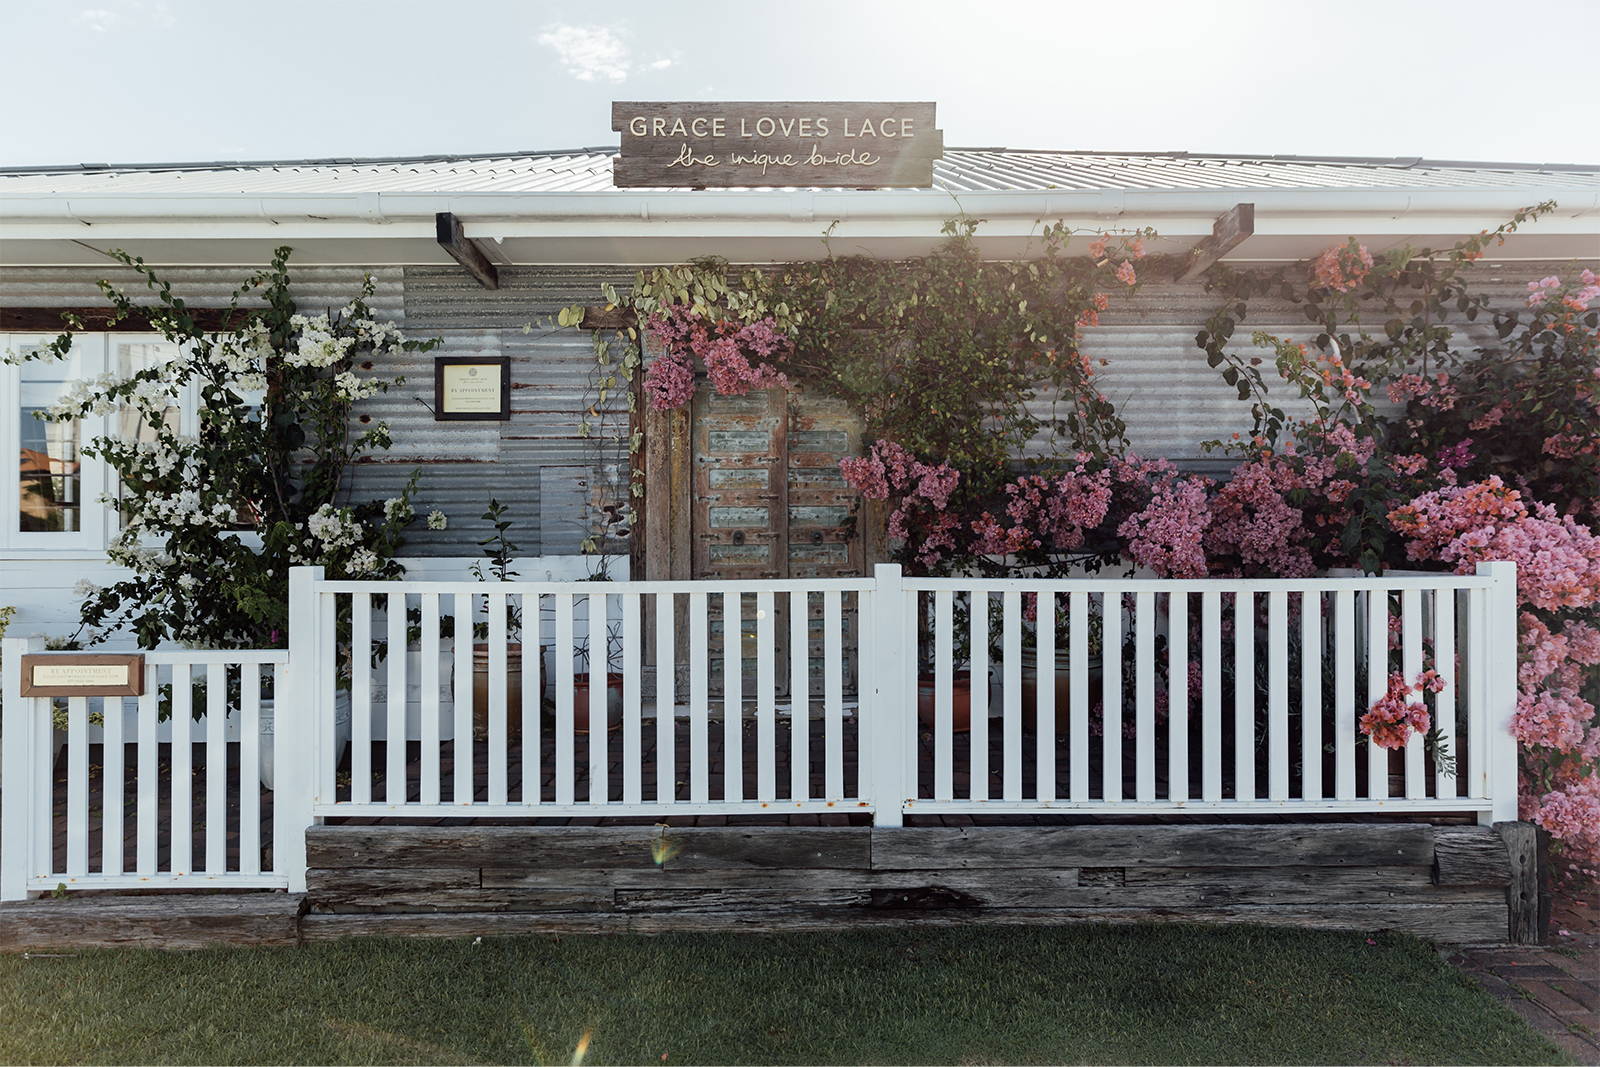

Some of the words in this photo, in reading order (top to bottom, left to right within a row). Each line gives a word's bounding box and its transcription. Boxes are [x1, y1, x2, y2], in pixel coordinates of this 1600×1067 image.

[629, 117, 726, 138] GRACE
[740, 117, 829, 138] LOVES
[844, 117, 915, 138] LACE
[666, 143, 721, 168] the
[802, 143, 881, 166] bride
